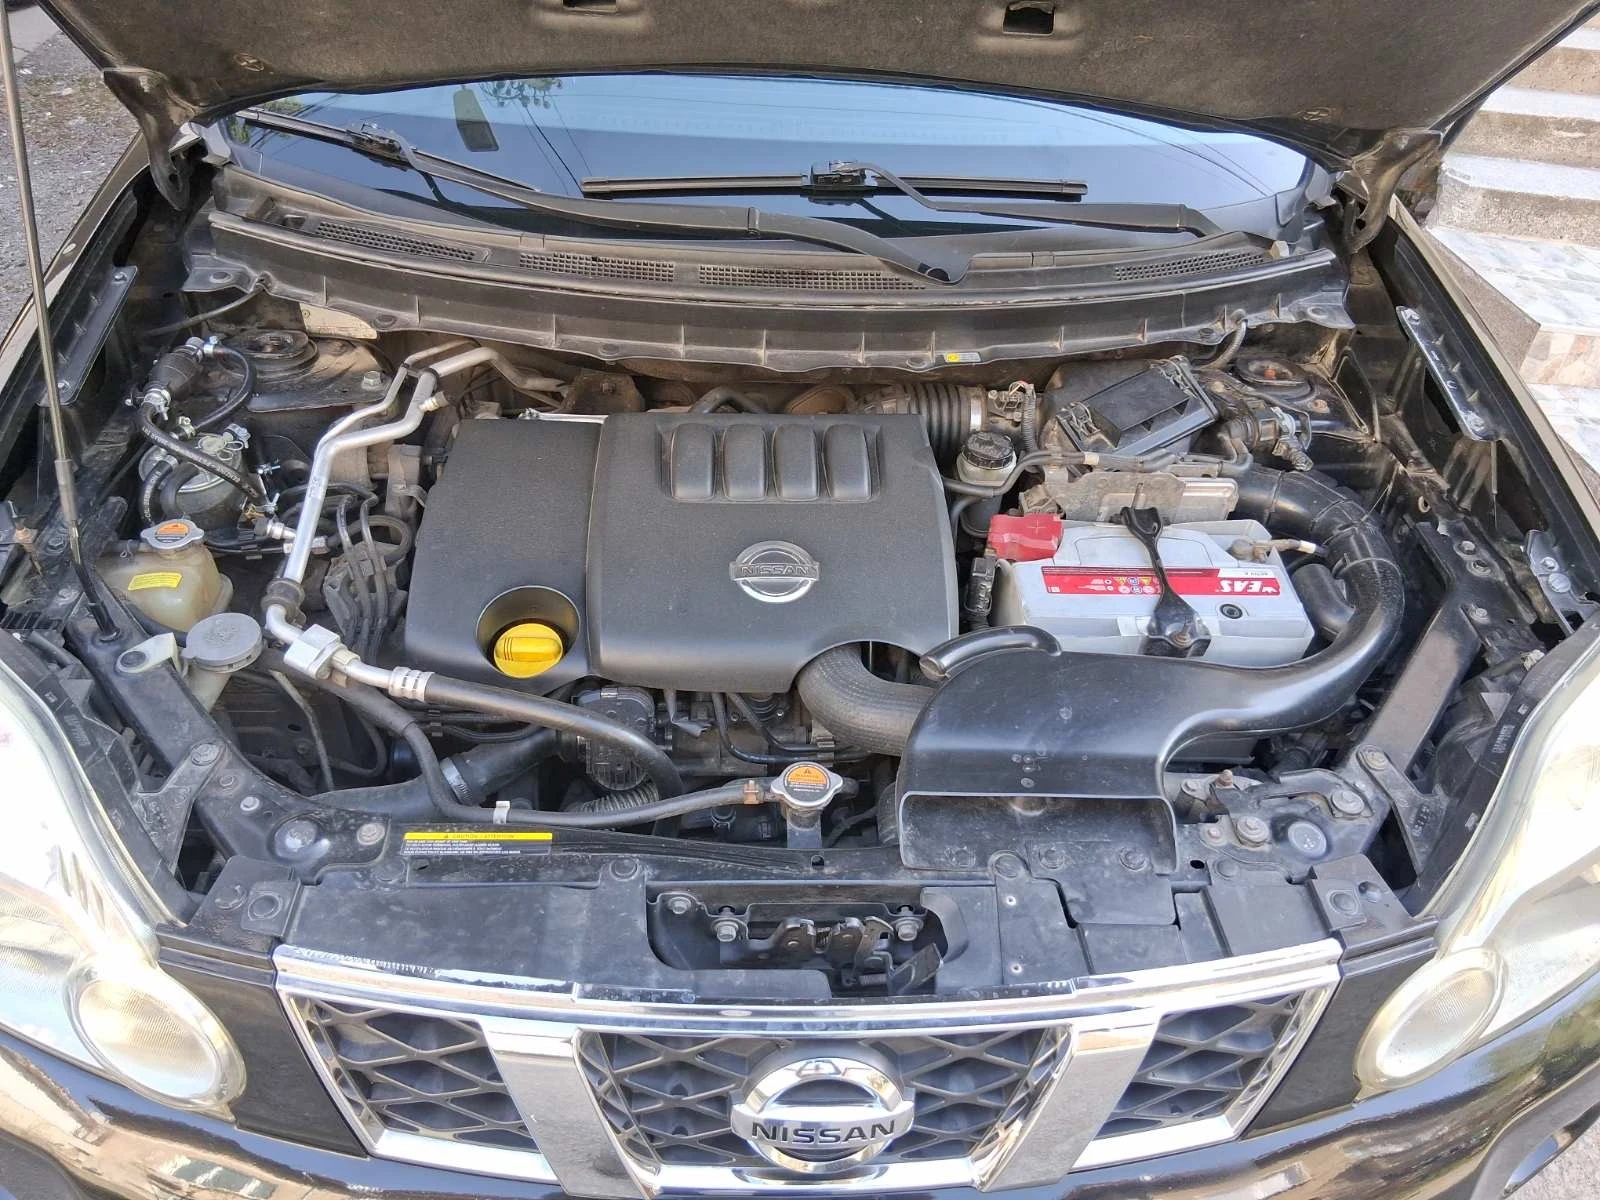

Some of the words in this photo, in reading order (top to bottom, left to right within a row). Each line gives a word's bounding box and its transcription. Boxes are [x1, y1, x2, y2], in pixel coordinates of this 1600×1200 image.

[741, 565, 809, 576] NISSAN
[1220, 580, 1262, 593] EAS
[752, 1120, 896, 1144] NISSAN
